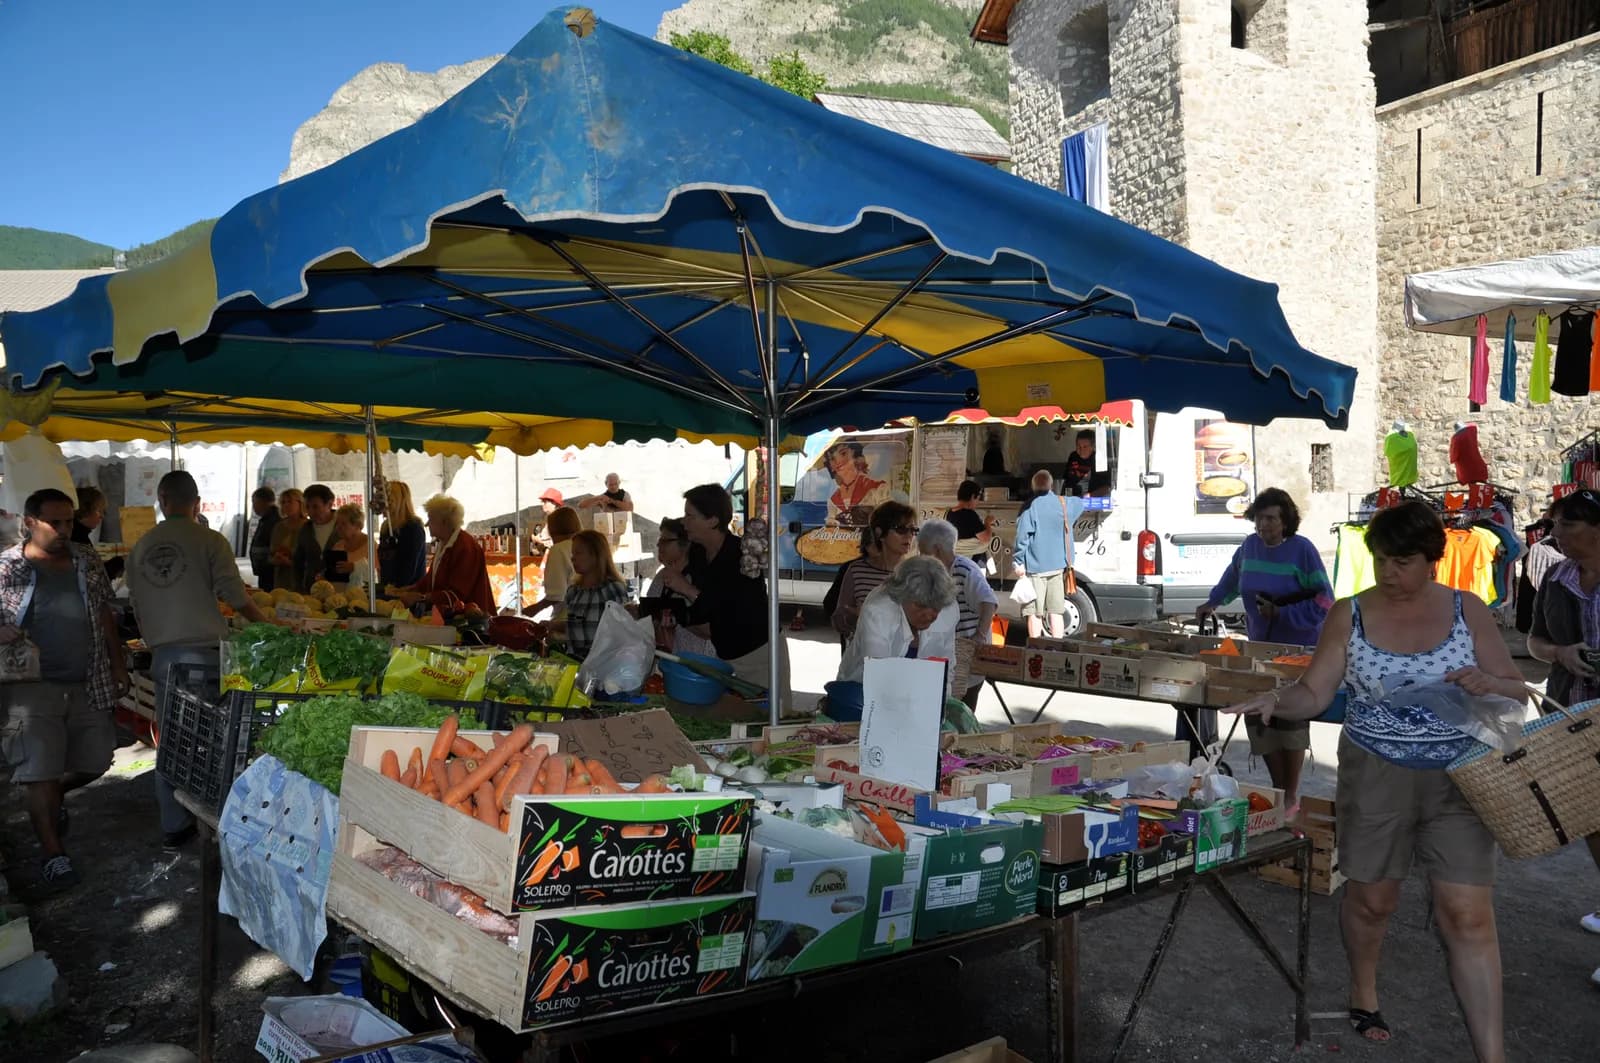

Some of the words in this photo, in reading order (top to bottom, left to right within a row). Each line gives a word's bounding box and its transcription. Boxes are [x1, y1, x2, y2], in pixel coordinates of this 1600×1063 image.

[1085, 539, 1106, 556] 26
[420, 667, 449, 682] SOUPE
[859, 779, 915, 806] Caillo
[1186, 817, 1195, 832] olet
[589, 848, 686, 879] Carottes
[523, 883, 571, 899] SOLEPRO
[814, 881, 847, 894] FLANDRIA
[598, 953, 691, 989] Carottes
[534, 995, 581, 1014] SOLEPRO
